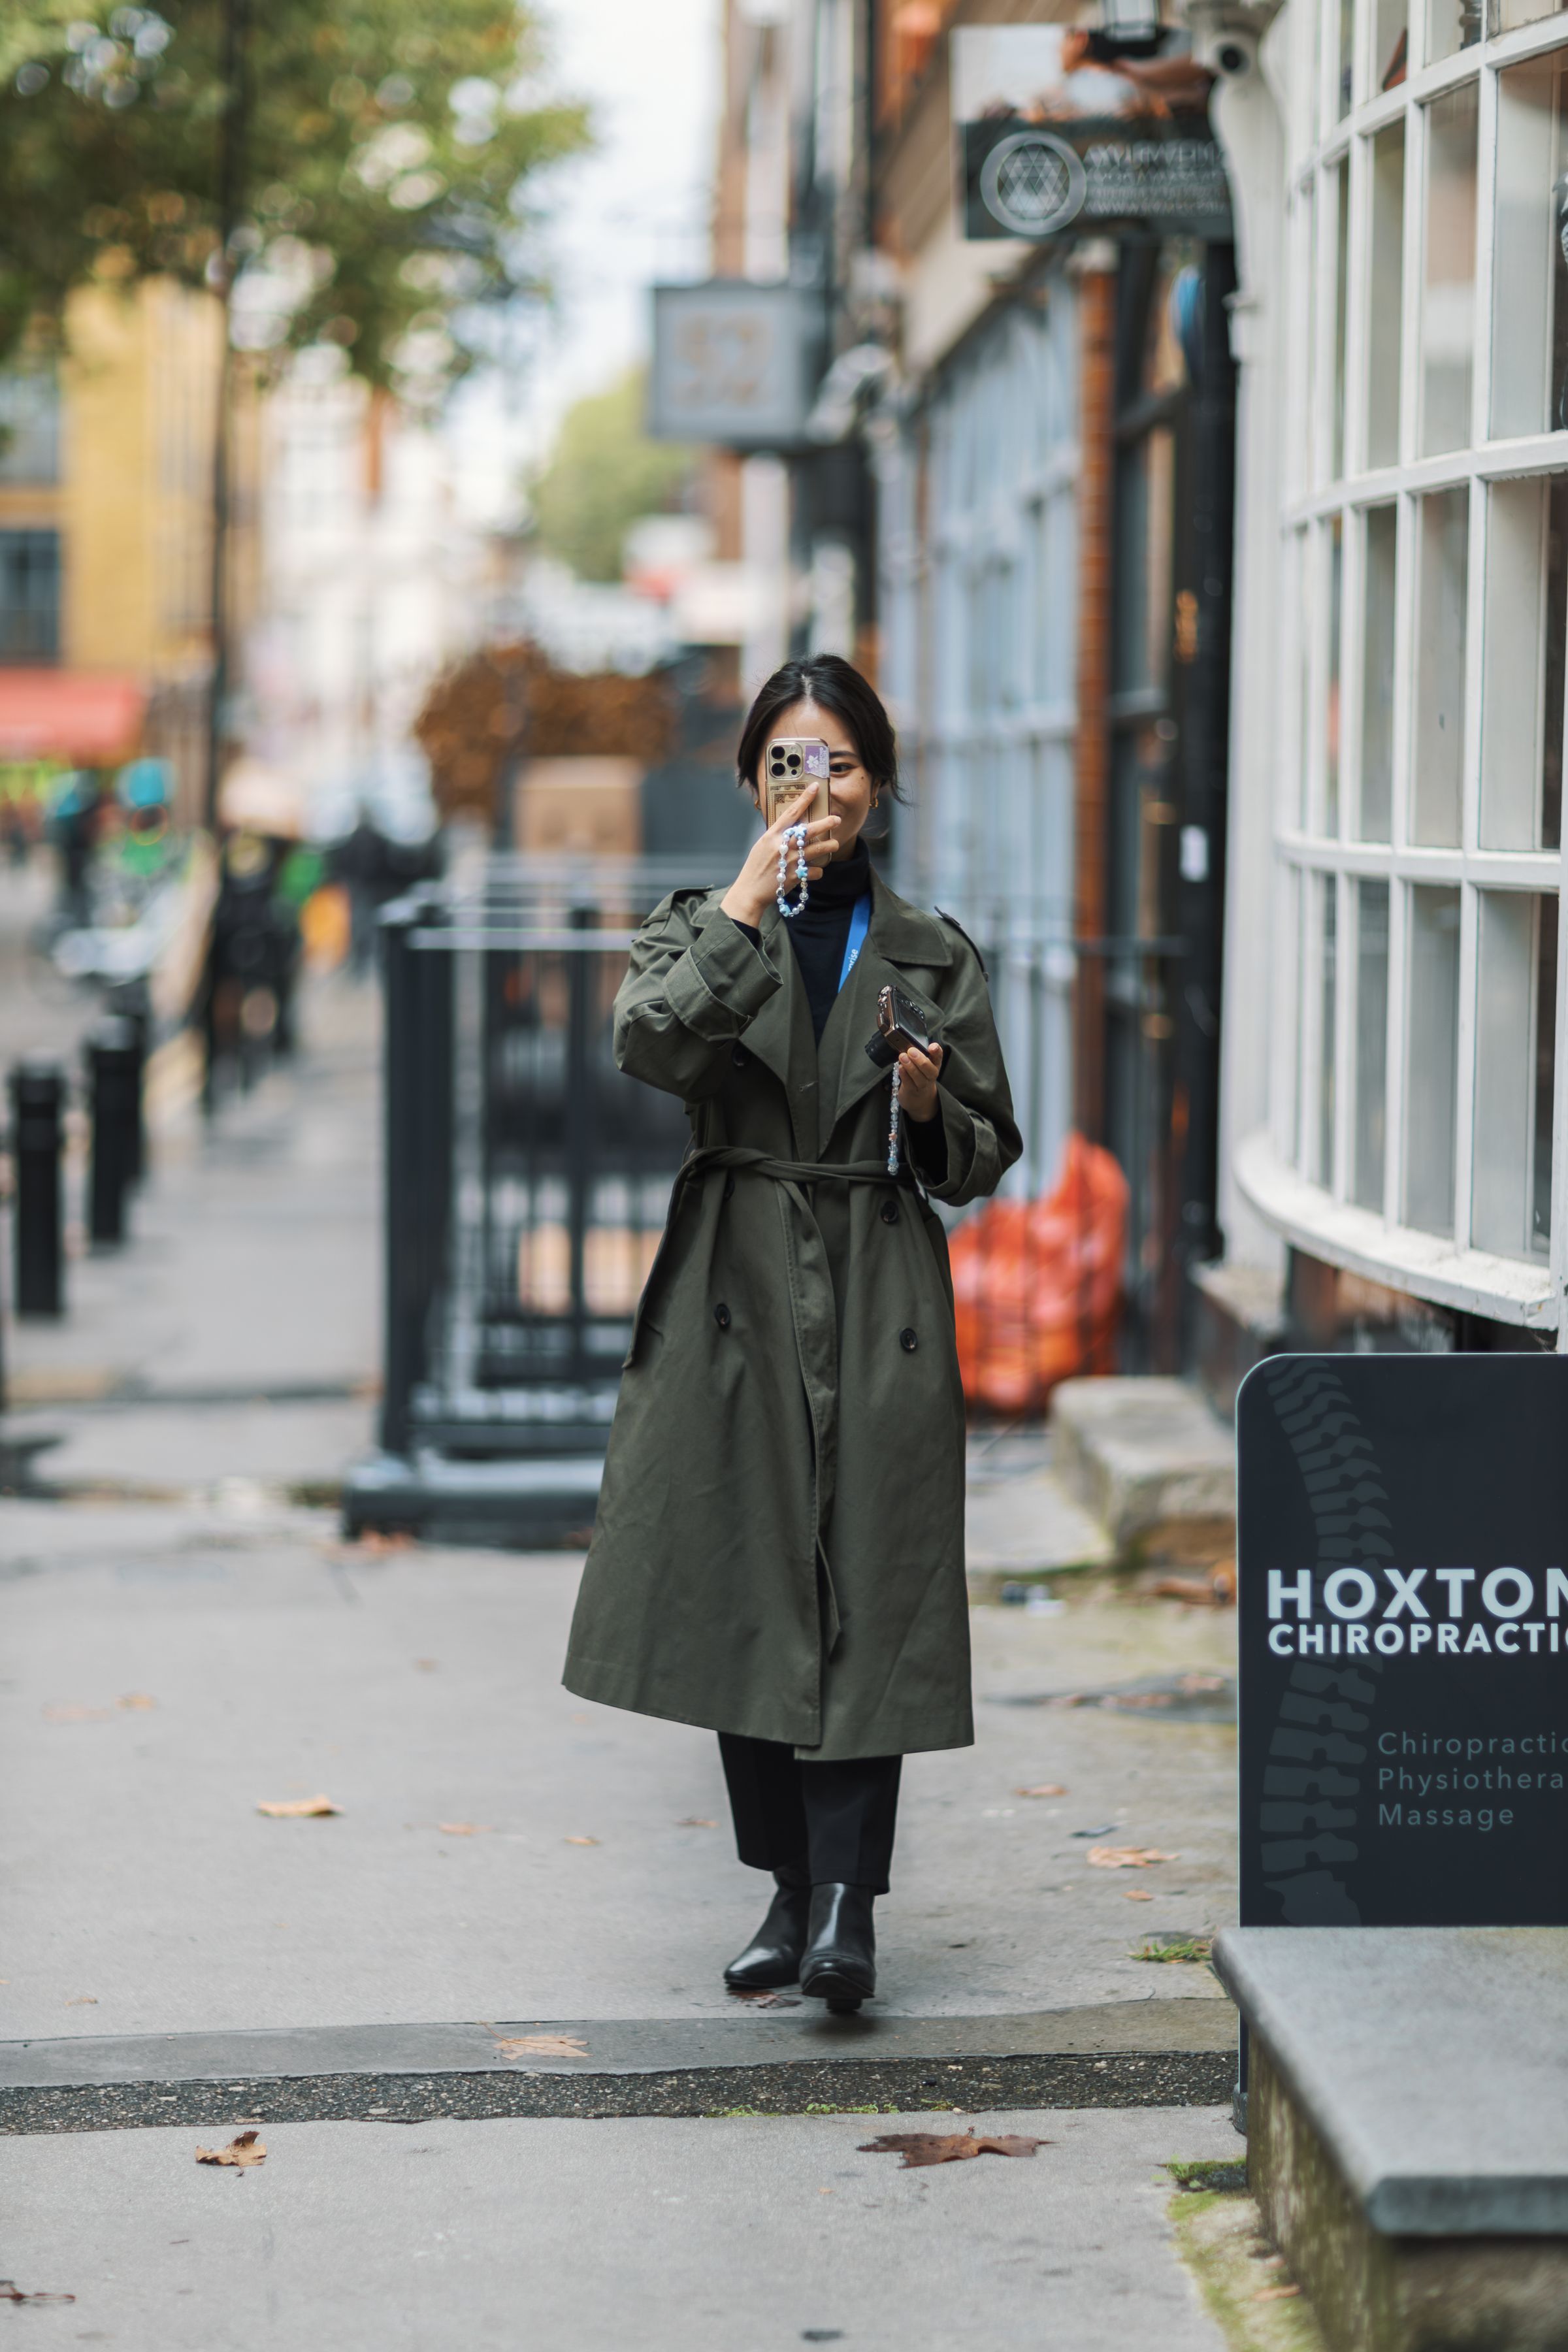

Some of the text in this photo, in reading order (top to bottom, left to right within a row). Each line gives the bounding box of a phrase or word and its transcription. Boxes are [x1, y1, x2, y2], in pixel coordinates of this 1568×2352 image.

[1268, 1622, 1568, 1656] CHIROPRACTI
[1379, 1766, 1563, 1796] Physiothera
[1379, 1803, 1514, 1832] Massage
